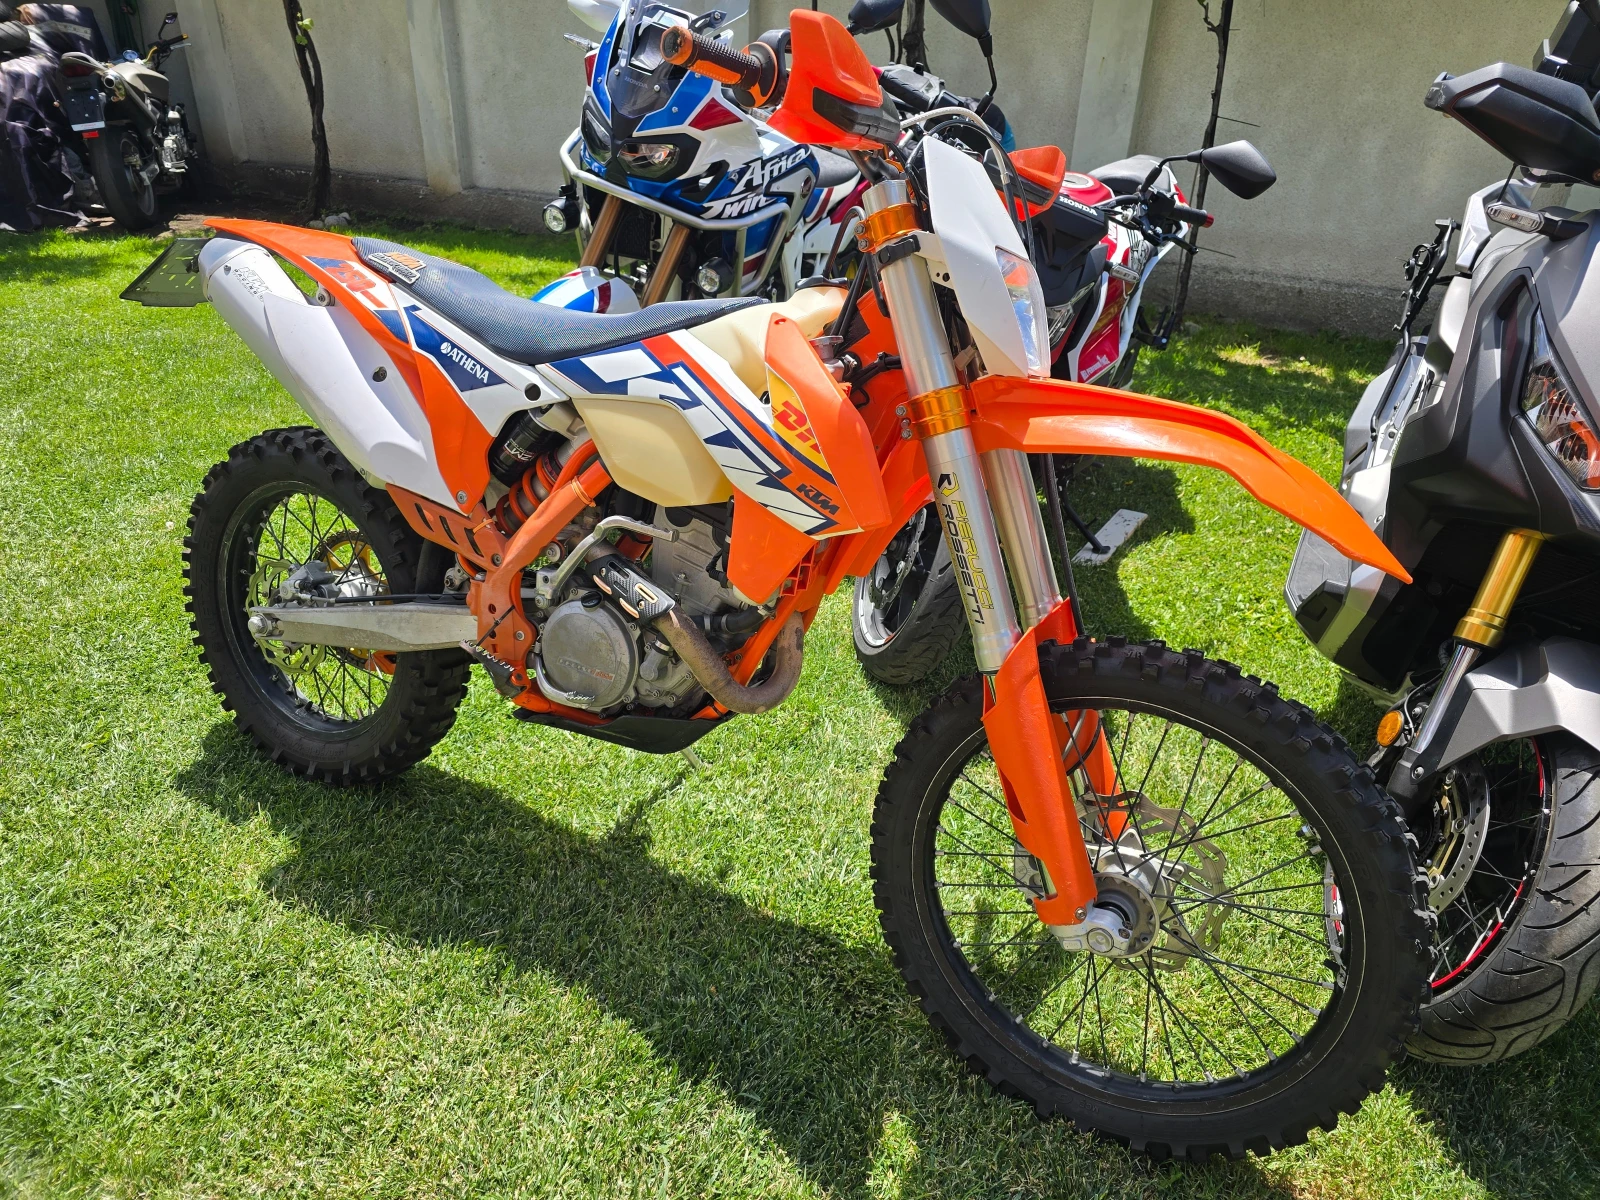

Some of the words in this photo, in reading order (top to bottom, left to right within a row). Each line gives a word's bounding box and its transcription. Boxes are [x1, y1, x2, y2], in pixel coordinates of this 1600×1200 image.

[624, 75, 649, 89] HONDA
[731, 148, 812, 196] Africa
[700, 191, 777, 220] Twin
[1059, 195, 1098, 216] HONDA
[330, 263, 377, 293] 250
[447, 347, 490, 384] ATHENA
[774, 400, 822, 455] DH
[796, 482, 841, 516] KTM
